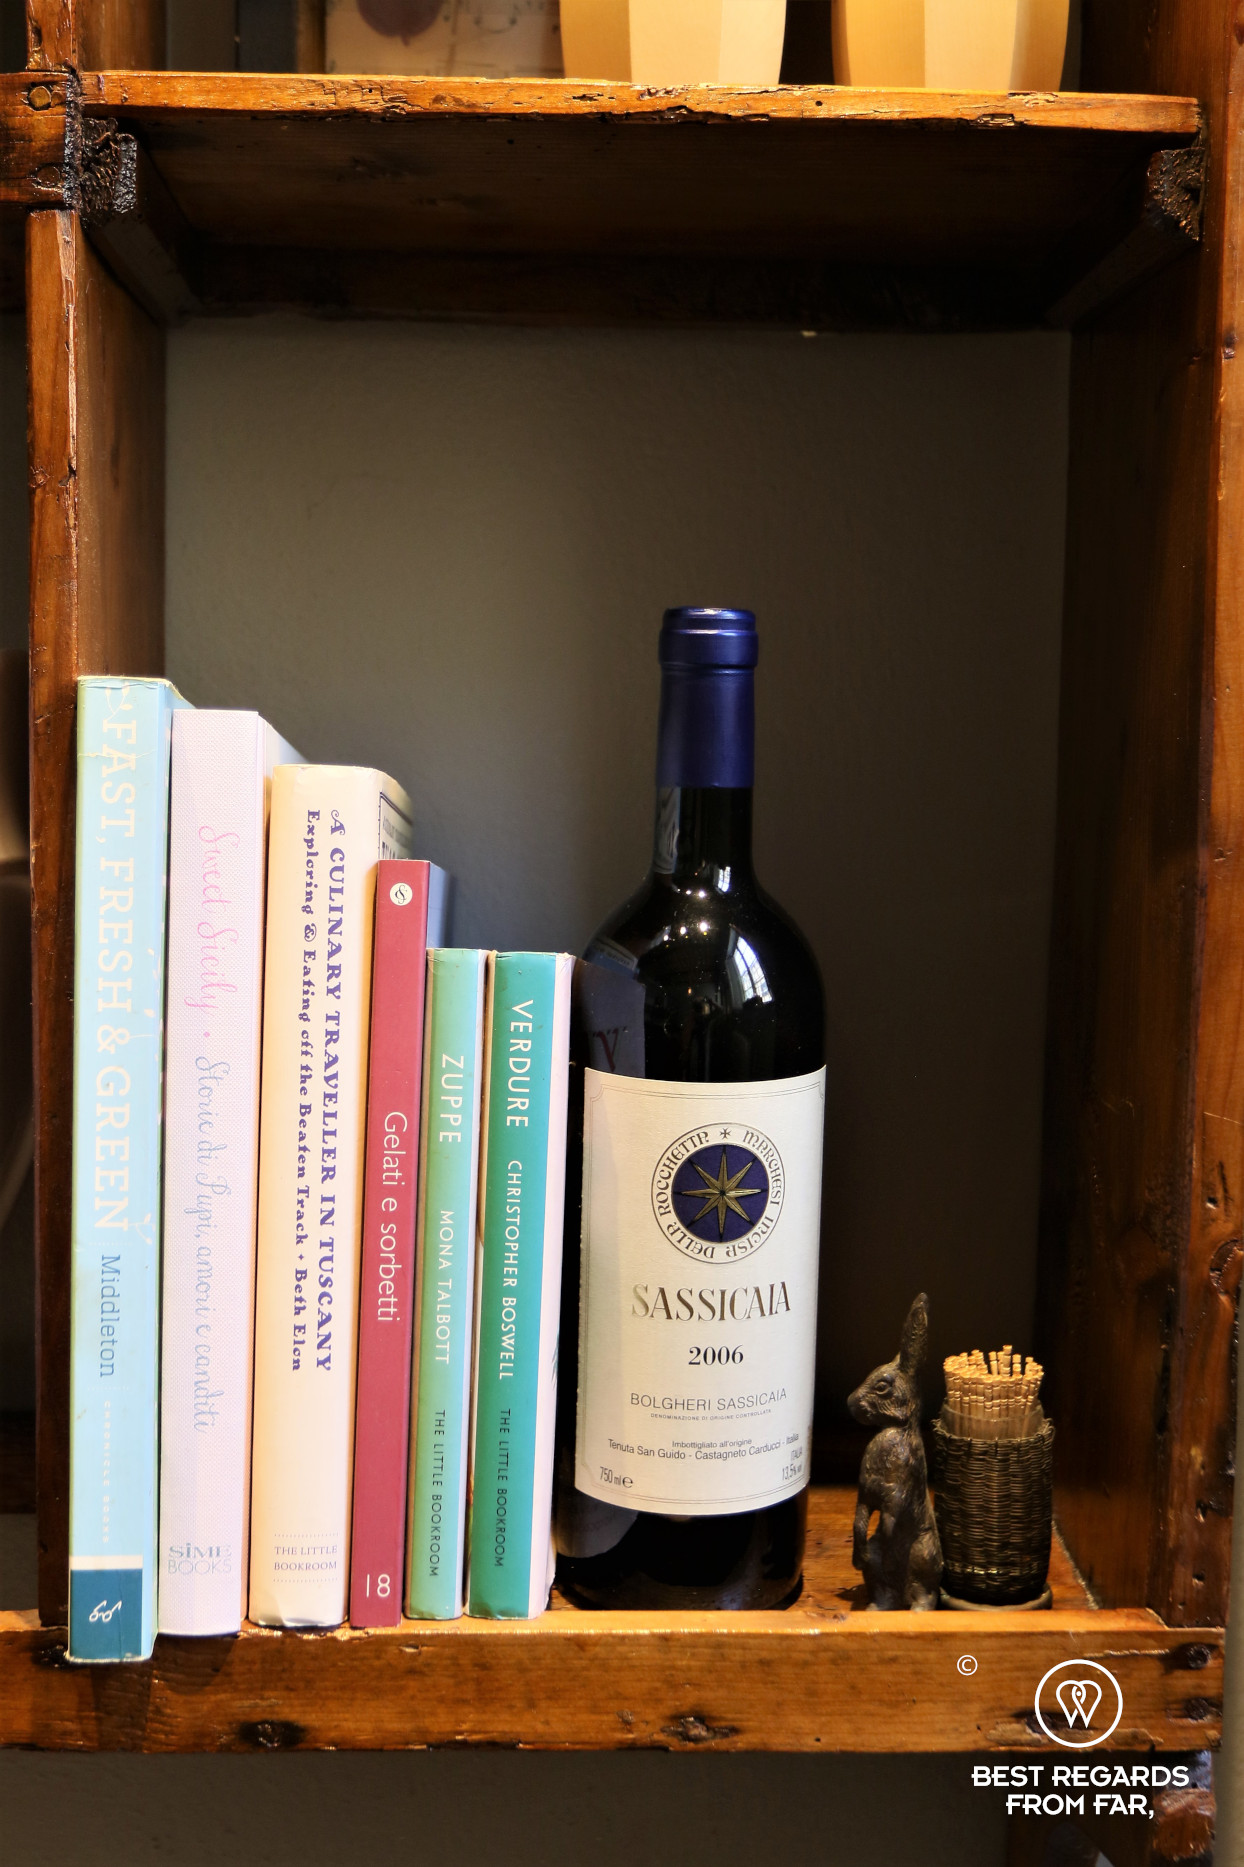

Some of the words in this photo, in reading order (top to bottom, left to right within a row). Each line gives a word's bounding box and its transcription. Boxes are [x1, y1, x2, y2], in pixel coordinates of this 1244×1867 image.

[96, 719, 137, 843] FAST,
[329, 809, 346, 836] A
[198, 825, 241, 914] Sweet
[301, 809, 321, 915] Exploring
[97, 857, 135, 1014] FRESH
[304, 922, 317, 942] &
[325, 847, 345, 1000] CULINARY
[184, 921, 240, 1018] Sicily
[298, 949, 316, 1022] Eating
[96, 1024, 130, 1055] &
[300, 1029, 314, 1058] off
[506, 999, 534, 1127] VERDURE
[194, 1056, 231, 1134] Storie
[299, 1064, 314, 1097] the
[321, 1010, 341, 1184] TRAVELLER
[439, 1054, 464, 1143] ZUPPE
[94, 1065, 131, 1231] GREEN
[196, 1140, 228, 1166] di
[297, 1103, 312, 1179] Beaten
[382, 1111, 408, 1186] Gelati
[742, 1129, 783, 1206] MARCHESI
[656, 1130, 710, 1216] ROCCHETTA
[295, 1185, 310, 1245] Track
[319, 1195, 336, 1226] IN
[381, 1198, 397, 1212] e
[502, 1160, 522, 1287] CHRISTOPHER
[438, 1210, 455, 1270] MONA
[195, 1245, 218, 1318] amori
[293, 1267, 308, 1316] Beth
[377, 1223, 402, 1321] sorbetti
[631, 1281, 791, 1322] SASSICAIA
[100, 1254, 120, 1378] Middleton
[196, 1324, 212, 1339] e
[316, 1236, 335, 1371] TUSCANY
[435, 1278, 452, 1364] TALBOTT
[292, 1323, 307, 1371] Elon
[499, 1297, 517, 1380] BOSWELL
[688, 1344, 744, 1366] 2006
[192, 1344, 225, 1433] canditi
[630, 1392, 711, 1411] BOLGHERI
[717, 1388, 787, 1411] SASSICAIA
[650, 1413, 700, 1421] DENOMINAZIONE
[434, 1409, 446, 1436] THE
[499, 1408, 511, 1434] THE
[607, 1438, 635, 1454] Tenuta
[637, 1445, 655, 1457] San
[657, 1448, 686, 1460] Guido
[695, 1448, 747, 1461] Castagneto
[749, 1439, 781, 1456] Carducci
[672, 1440, 718, 1450] Imbottigliato
[719, 1438, 752, 1449] all'origine
[433, 1444, 444, 1486] LITTLE
[498, 1441, 509, 1481] LITTLE
[600, 1466, 613, 1484] 750
[613, 1474, 622, 1485] ml
[274, 1545, 298, 1556] THE
[300, 1544, 338, 1555] LITTLE
[429, 1494, 442, 1577] BOOKROOM
[494, 1489, 507, 1567] BOOKROOM
[168, 1559, 232, 1575] BOOKS
[274, 1561, 338, 1571] BOOKROOM
[366, 1573, 391, 1598] 18
